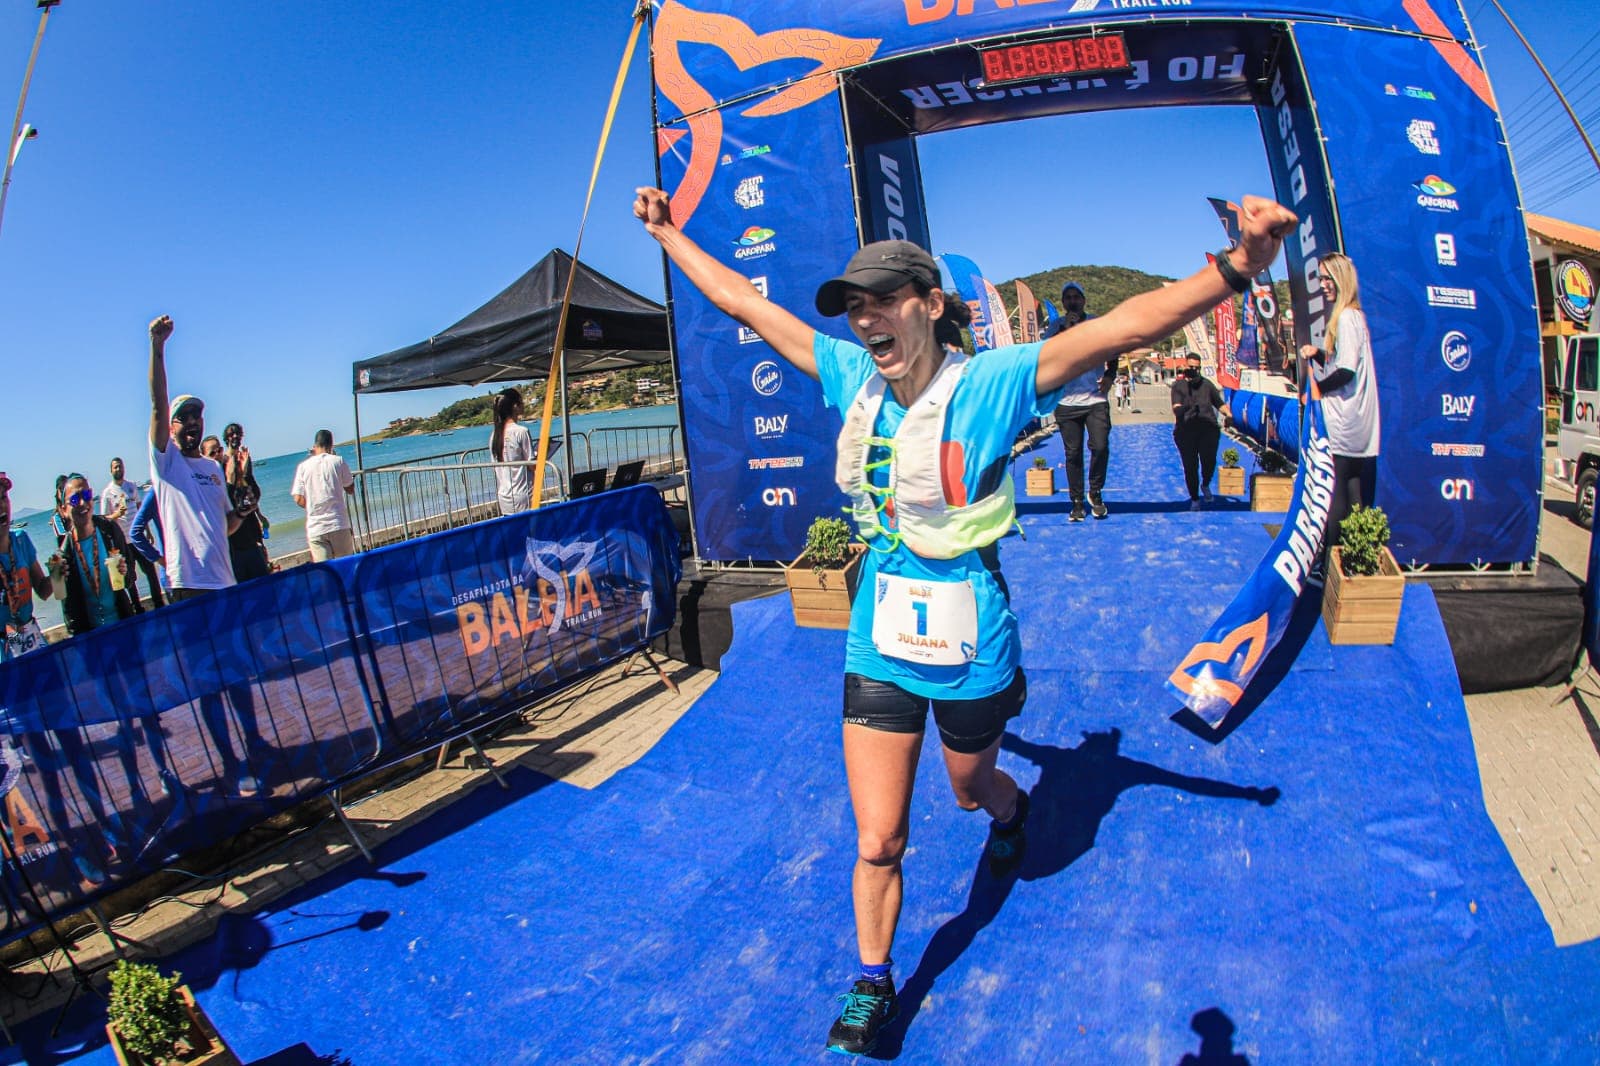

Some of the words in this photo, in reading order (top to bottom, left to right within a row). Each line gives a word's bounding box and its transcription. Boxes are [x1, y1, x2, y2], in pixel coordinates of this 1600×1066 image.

[1270, 67, 1307, 206] DESA
[735, 242, 776, 259] GAROPABA
[1441, 394, 1475, 417] BALY
[754, 414, 788, 436] BALY
[452, 584, 489, 606] DESAFIO
[489, 578, 511, 594] JOTA
[512, 574, 524, 586] DA
[566, 612, 588, 628] TRAIL
[588, 607, 602, 620] RUN
[912, 601, 928, 636] 1
[897, 632, 949, 649] JULIANA
[7, 853, 37, 872] TAIL
